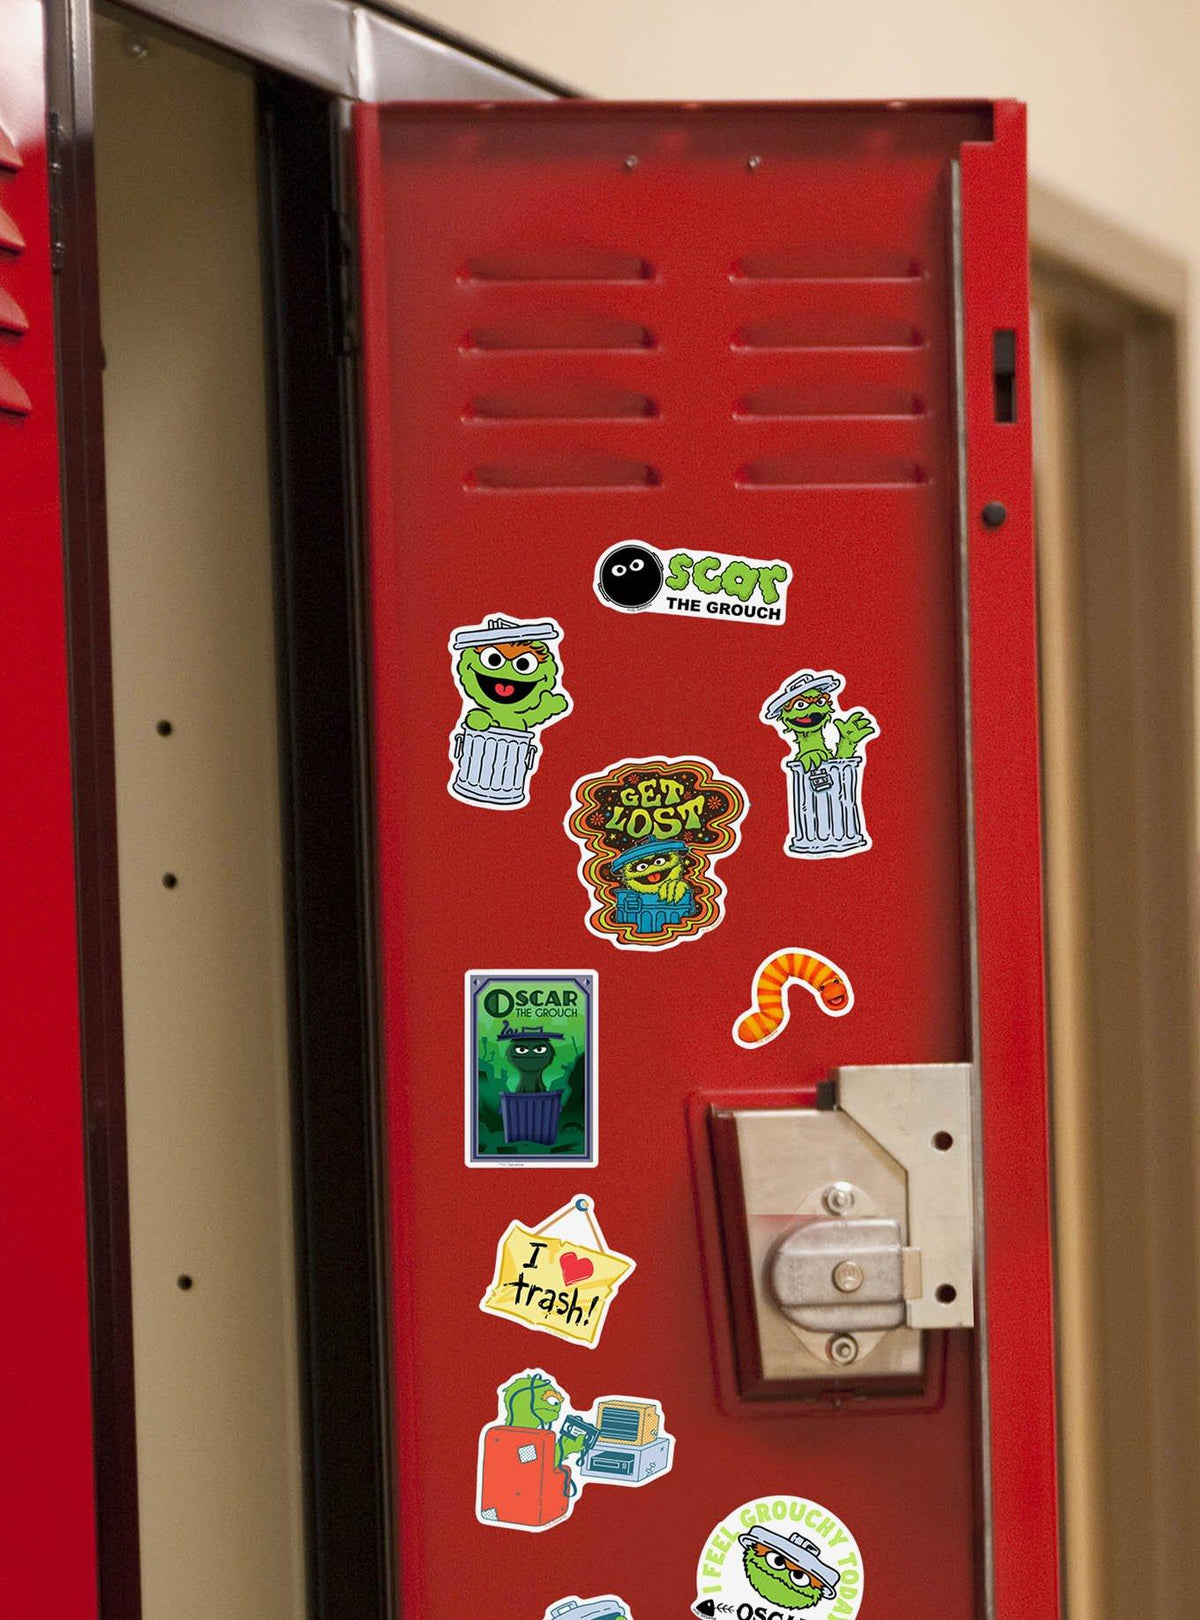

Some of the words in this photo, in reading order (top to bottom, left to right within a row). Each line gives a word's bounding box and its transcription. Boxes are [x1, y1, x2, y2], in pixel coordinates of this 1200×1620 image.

[666, 597, 701, 612] THE
[706, 601, 781, 620] GROUCH
[620, 779, 684, 807] GET
[605, 795, 705, 839] LOST
[484, 988, 578, 1018] OSCAR
[515, 1008, 532, 1018] THE
[535, 1008, 578, 1018] GROUCH
[523, 1242, 548, 1269] I
[503, 1272, 599, 1326] trash!
[739, 1500, 849, 1547] GROUCHY
[702, 1526, 740, 1579] FEEL
[702, 1585, 722, 1594] I
